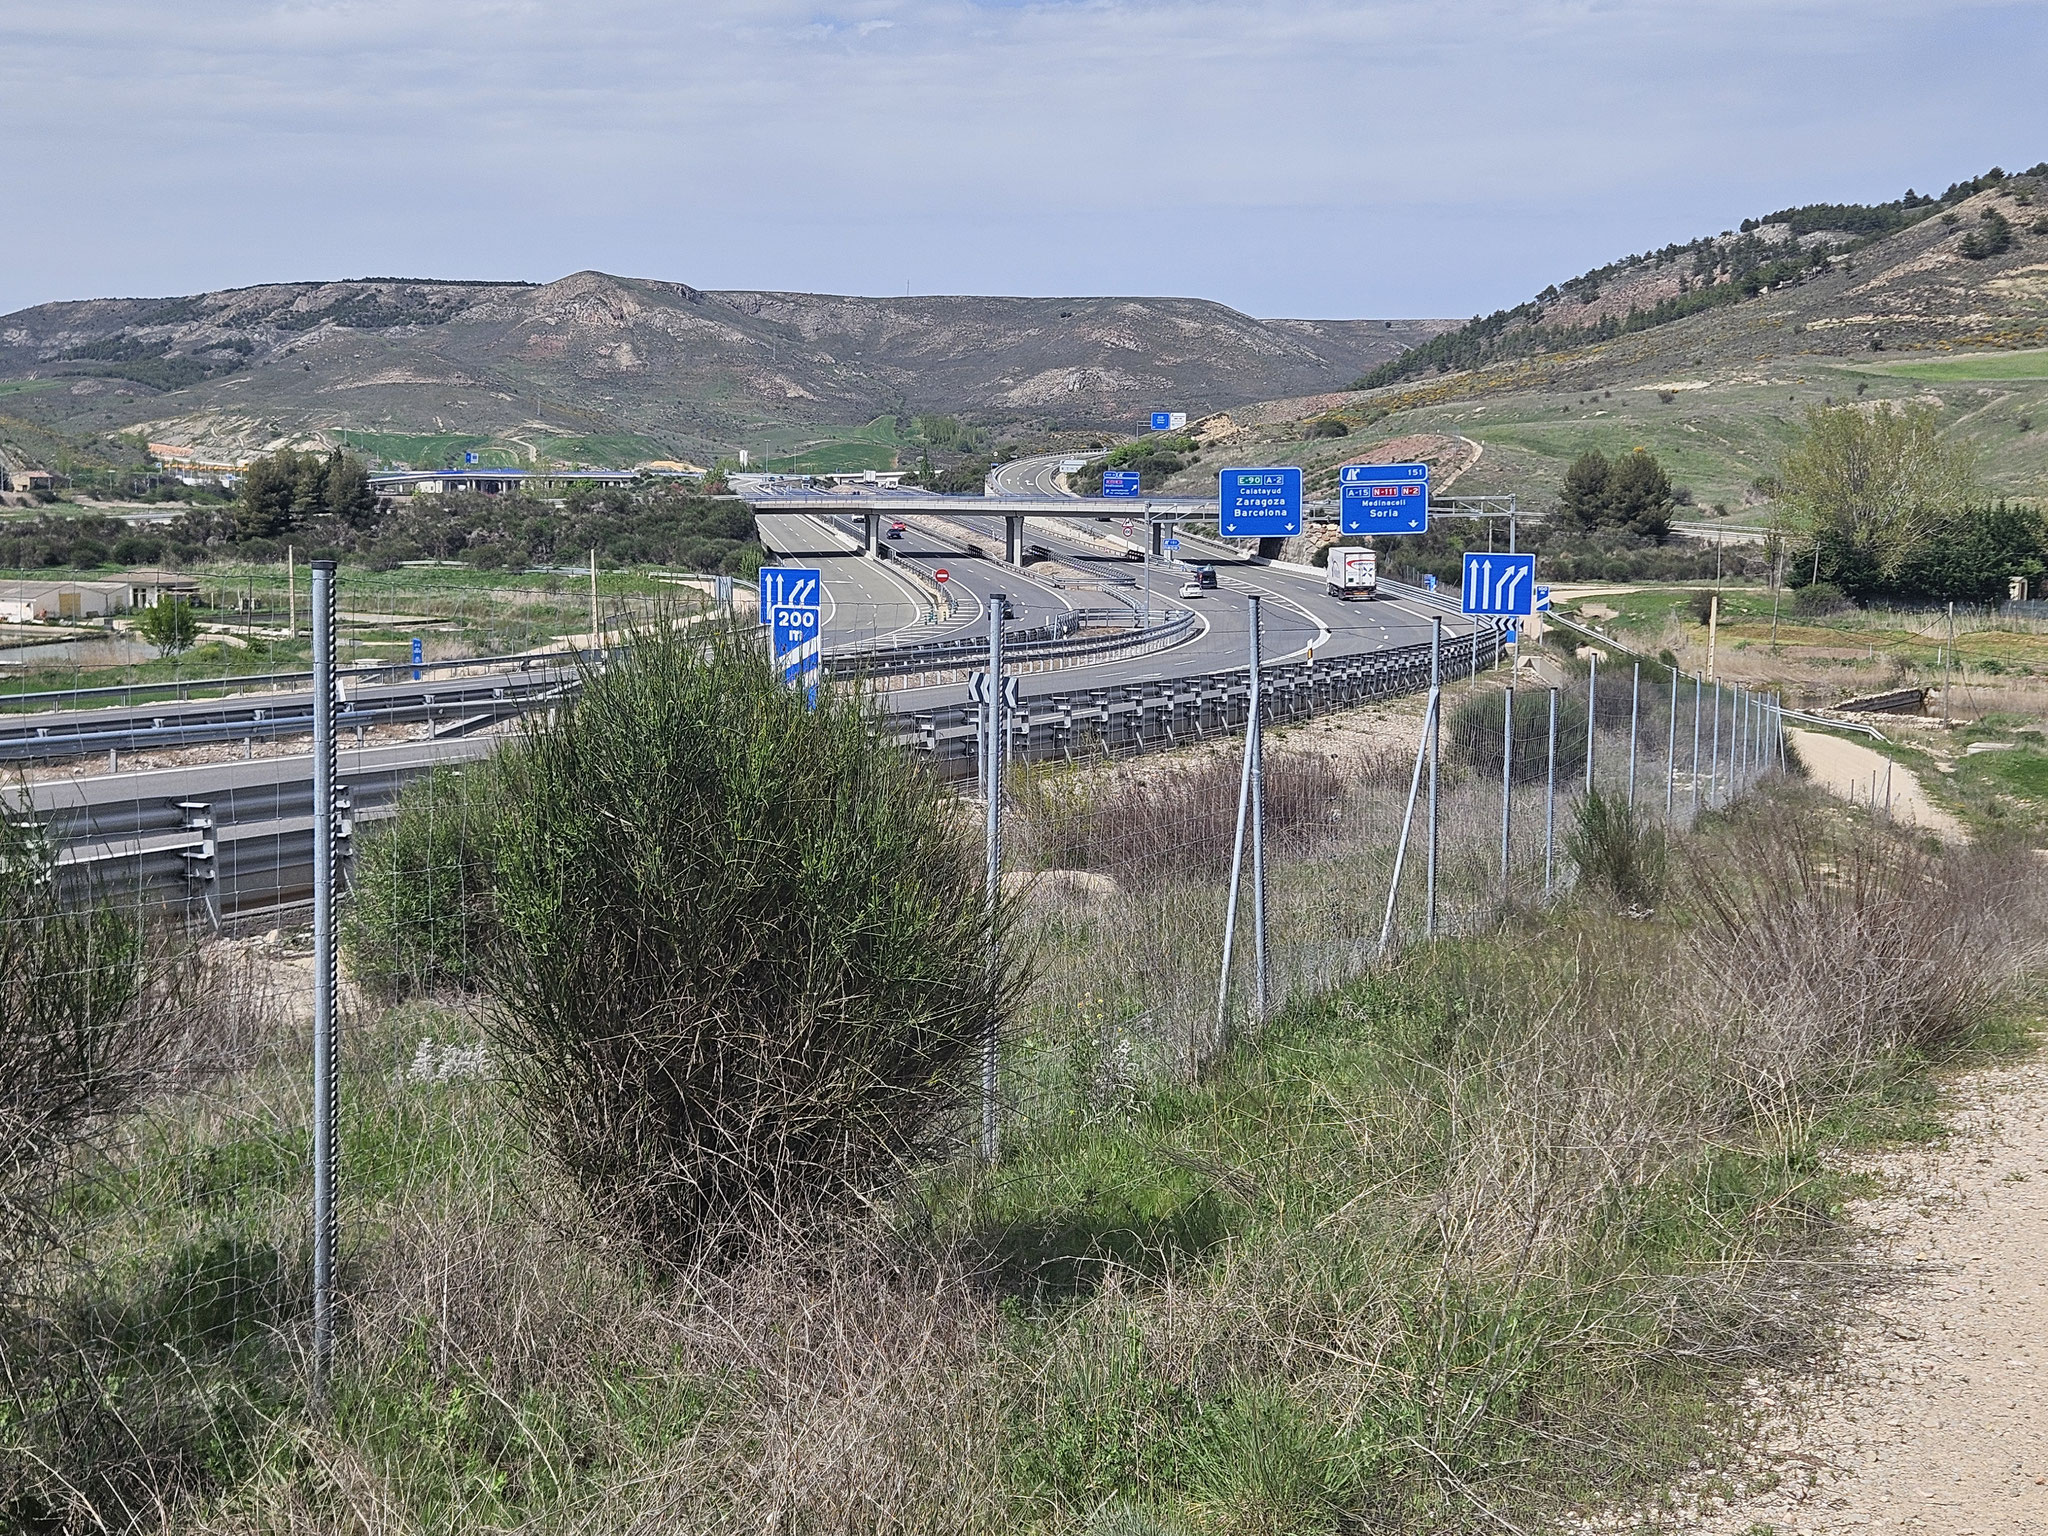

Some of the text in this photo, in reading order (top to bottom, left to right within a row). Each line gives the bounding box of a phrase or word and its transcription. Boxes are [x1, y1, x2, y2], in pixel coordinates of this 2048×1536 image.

[1407, 468, 1423, 476] 151
[1239, 476, 1282, 484] E-90 A-2
[1240, 488, 1282, 496] Calatayud
[1373, 487, 1397, 496] N-111
[1402, 487, 1419, 495] N-2
[1236, 498, 1286, 508] Zaragoza
[1361, 499, 1406, 507] Medinaceli
[1234, 508, 1288, 517] Barcelona
[1369, 508, 1399, 518] Soria
[778, 611, 814, 627] 200
[788, 629, 803, 642] m
